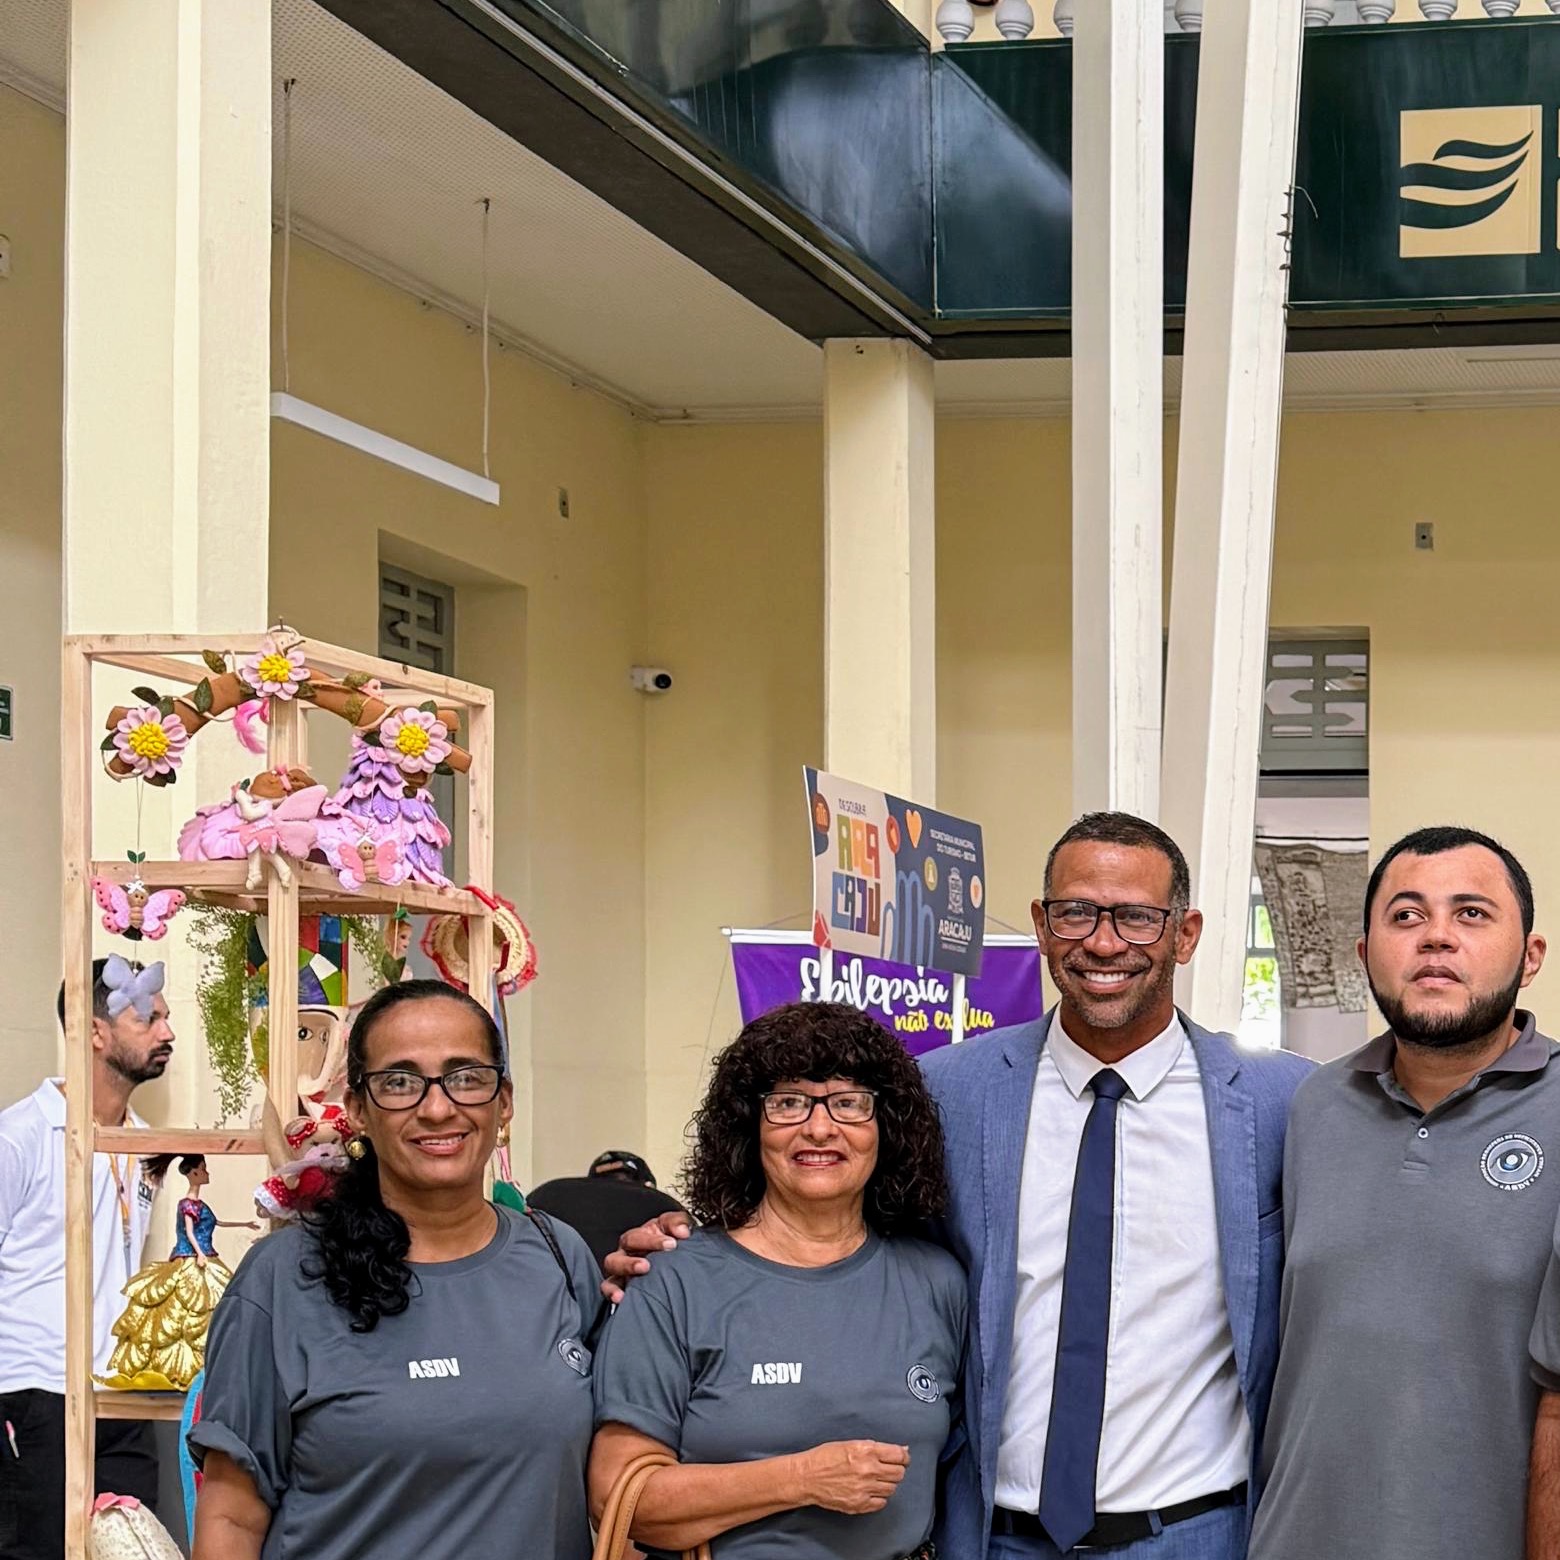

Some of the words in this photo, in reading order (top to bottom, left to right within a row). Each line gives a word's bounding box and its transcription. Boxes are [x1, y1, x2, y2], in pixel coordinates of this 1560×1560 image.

[938, 918, 972, 942] ARACAJU
[894, 1009, 929, 1033] não
[933, 998, 995, 1032] exlua
[408, 1357, 461, 1379] ASDV
[751, 1362, 802, 1385] ASDV
